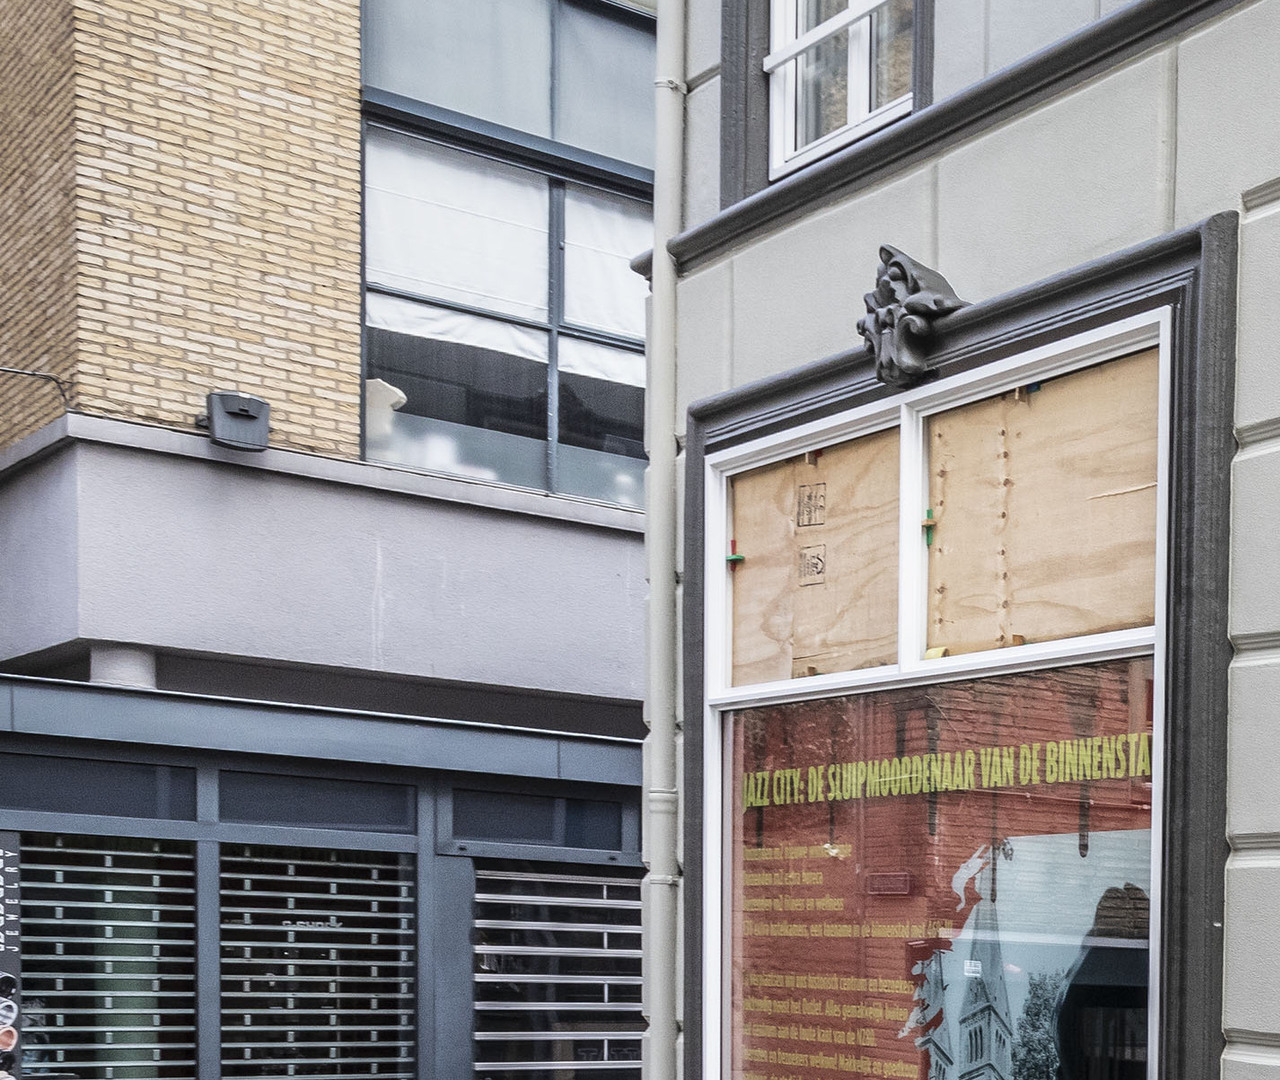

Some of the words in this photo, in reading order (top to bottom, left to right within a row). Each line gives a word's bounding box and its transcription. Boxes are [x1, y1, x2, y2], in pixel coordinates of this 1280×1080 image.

[744, 772, 769, 814] JAZZ
[773, 768, 804, 805] CITY:
[808, 766, 824, 802] DE
[828, 749, 975, 801] SLUIPMOORDENAAR
[980, 746, 1014, 788] VAN
[1019, 743, 1040, 785] DE
[1046, 732, 1150, 784] BINNENSTA
[5, 850, 20, 952] JEWELRY
